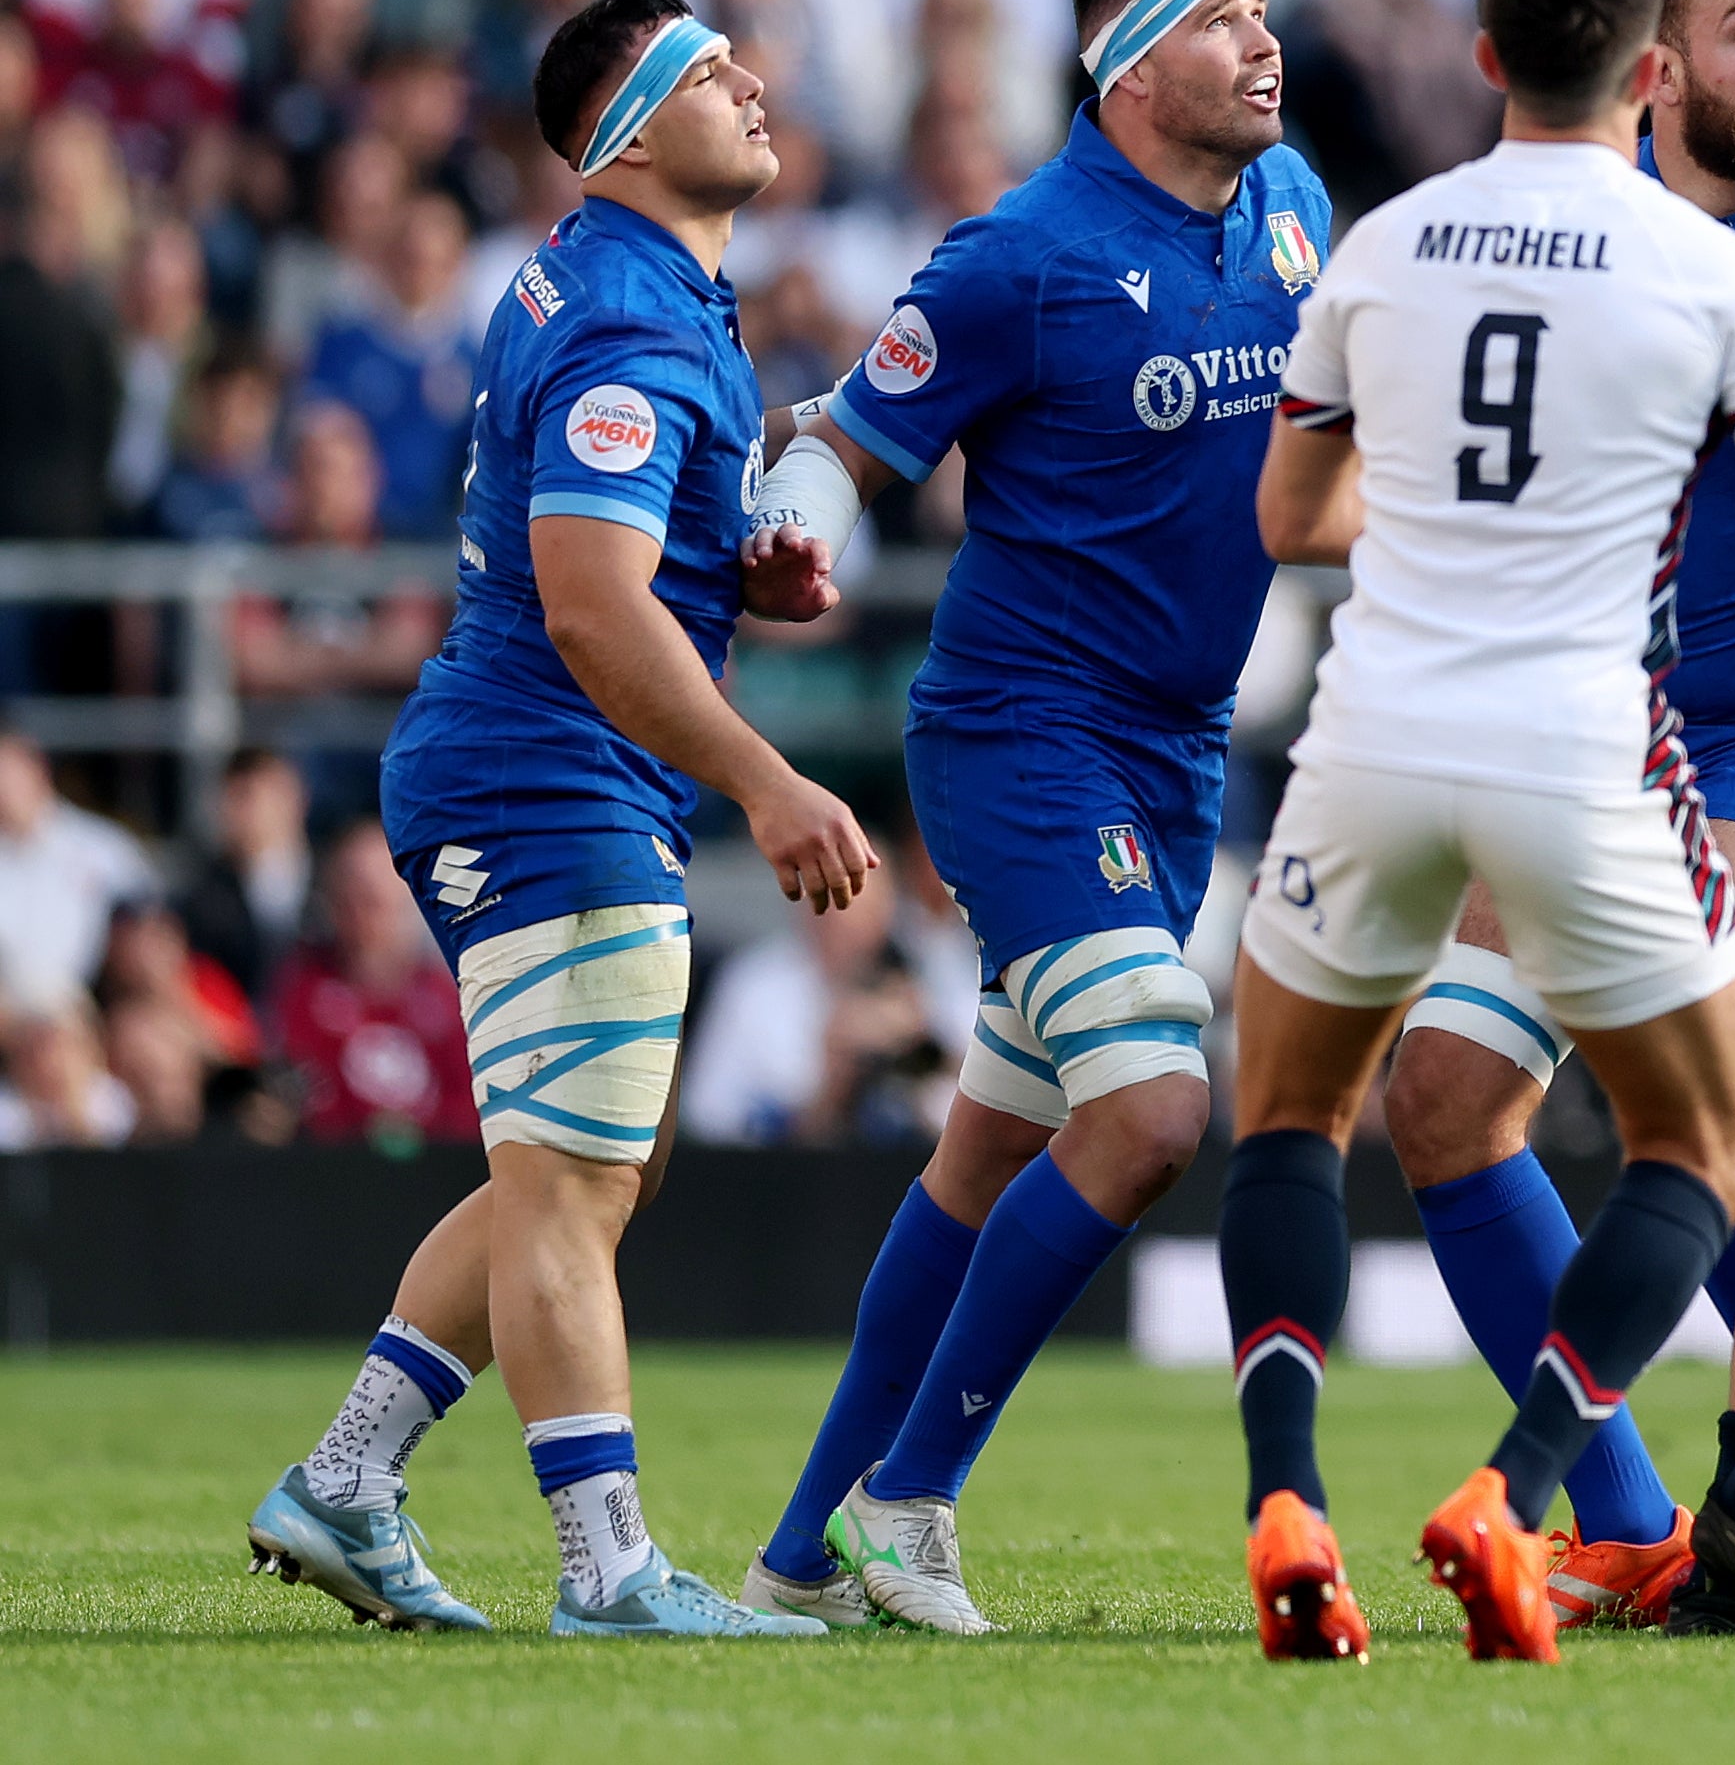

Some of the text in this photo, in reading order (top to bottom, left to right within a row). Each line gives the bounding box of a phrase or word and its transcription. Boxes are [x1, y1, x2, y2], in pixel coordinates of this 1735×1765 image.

[1416, 224, 1611, 272] MITCHELL
[895, 322, 934, 358] GUINNESS
[1138, 358, 1188, 385] VITTORIA
[1190, 343, 1293, 388] Vitto
[595, 404, 652, 428] GUINNESS
[1455, 313, 1550, 505] 9
